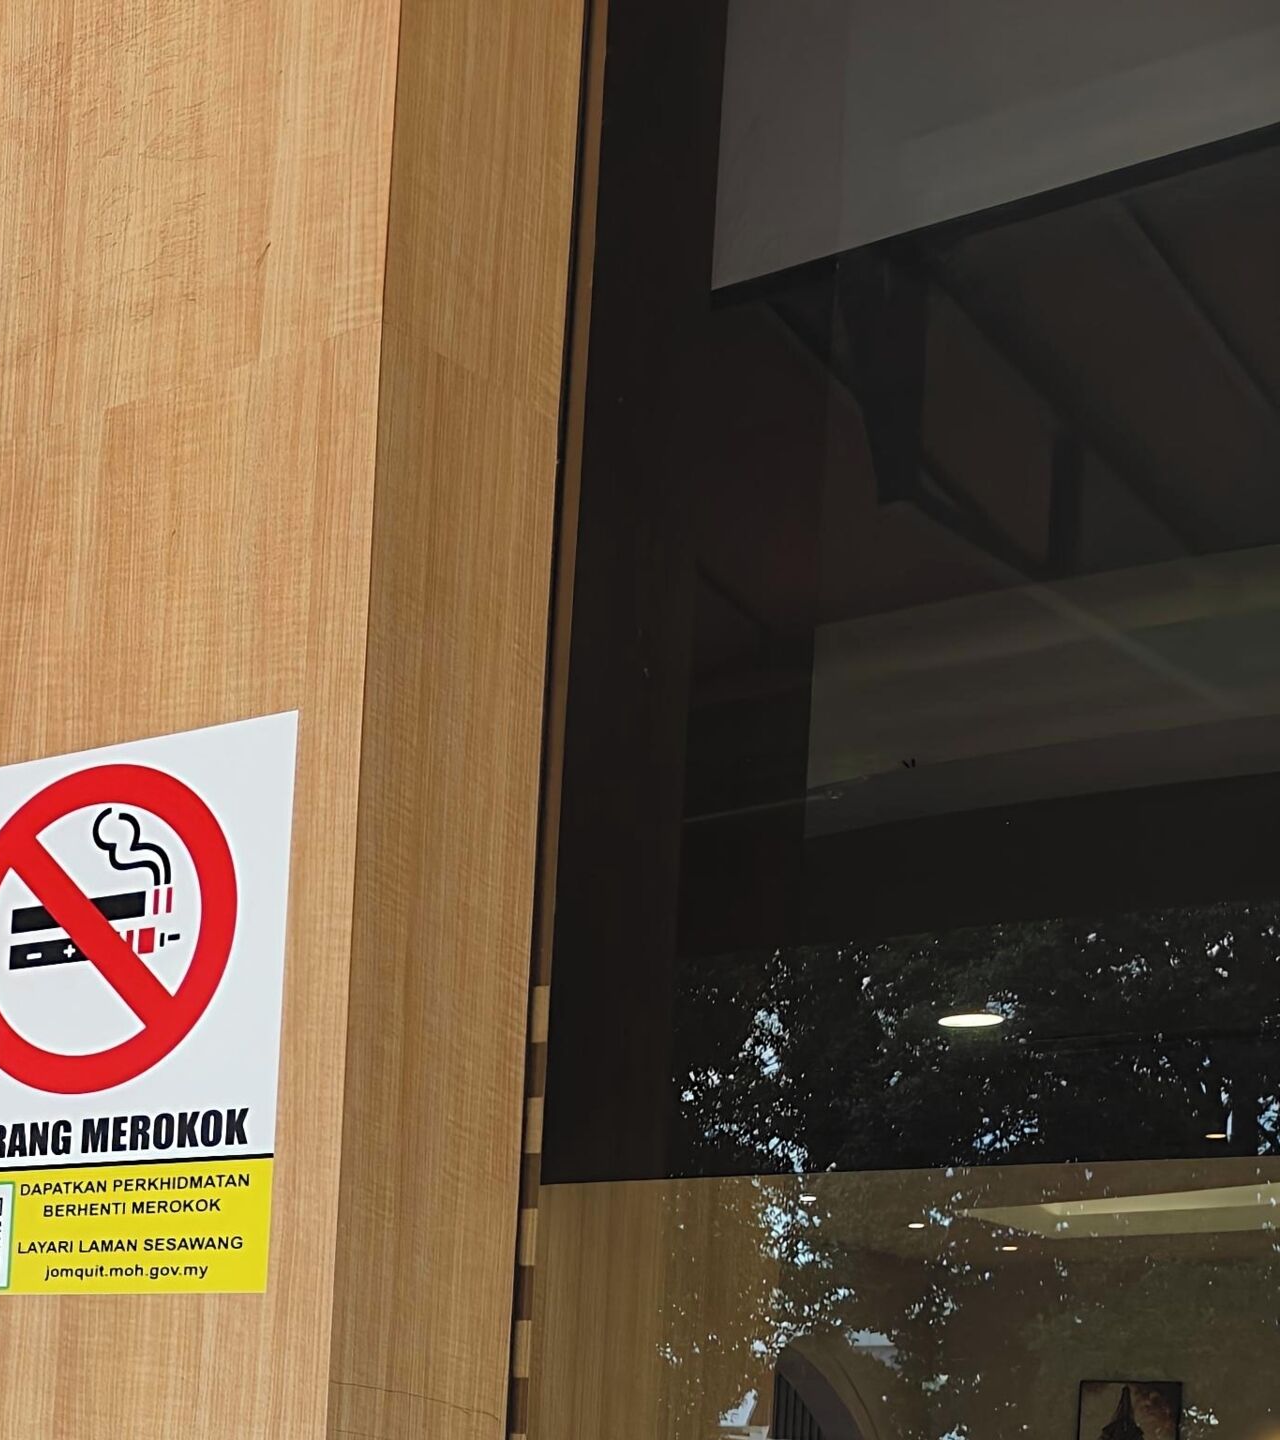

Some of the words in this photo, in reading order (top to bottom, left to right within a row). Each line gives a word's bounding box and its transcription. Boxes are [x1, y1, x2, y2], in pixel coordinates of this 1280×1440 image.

[80, 1107, 250, 1155] MEROKOK
[20, 1178, 107, 1197] DAPATKAN
[112, 1174, 251, 1193] PERKHIDMATAN
[43, 1201, 127, 1218] BERHENTI
[131, 1198, 221, 1215] MEROKOK
[17, 1239, 76, 1255] LAYARI
[78, 1237, 138, 1253] LAMAN
[143, 1235, 244, 1251] SESAWANG
[44, 1263, 209, 1280] jomquit.moh.gov.my
